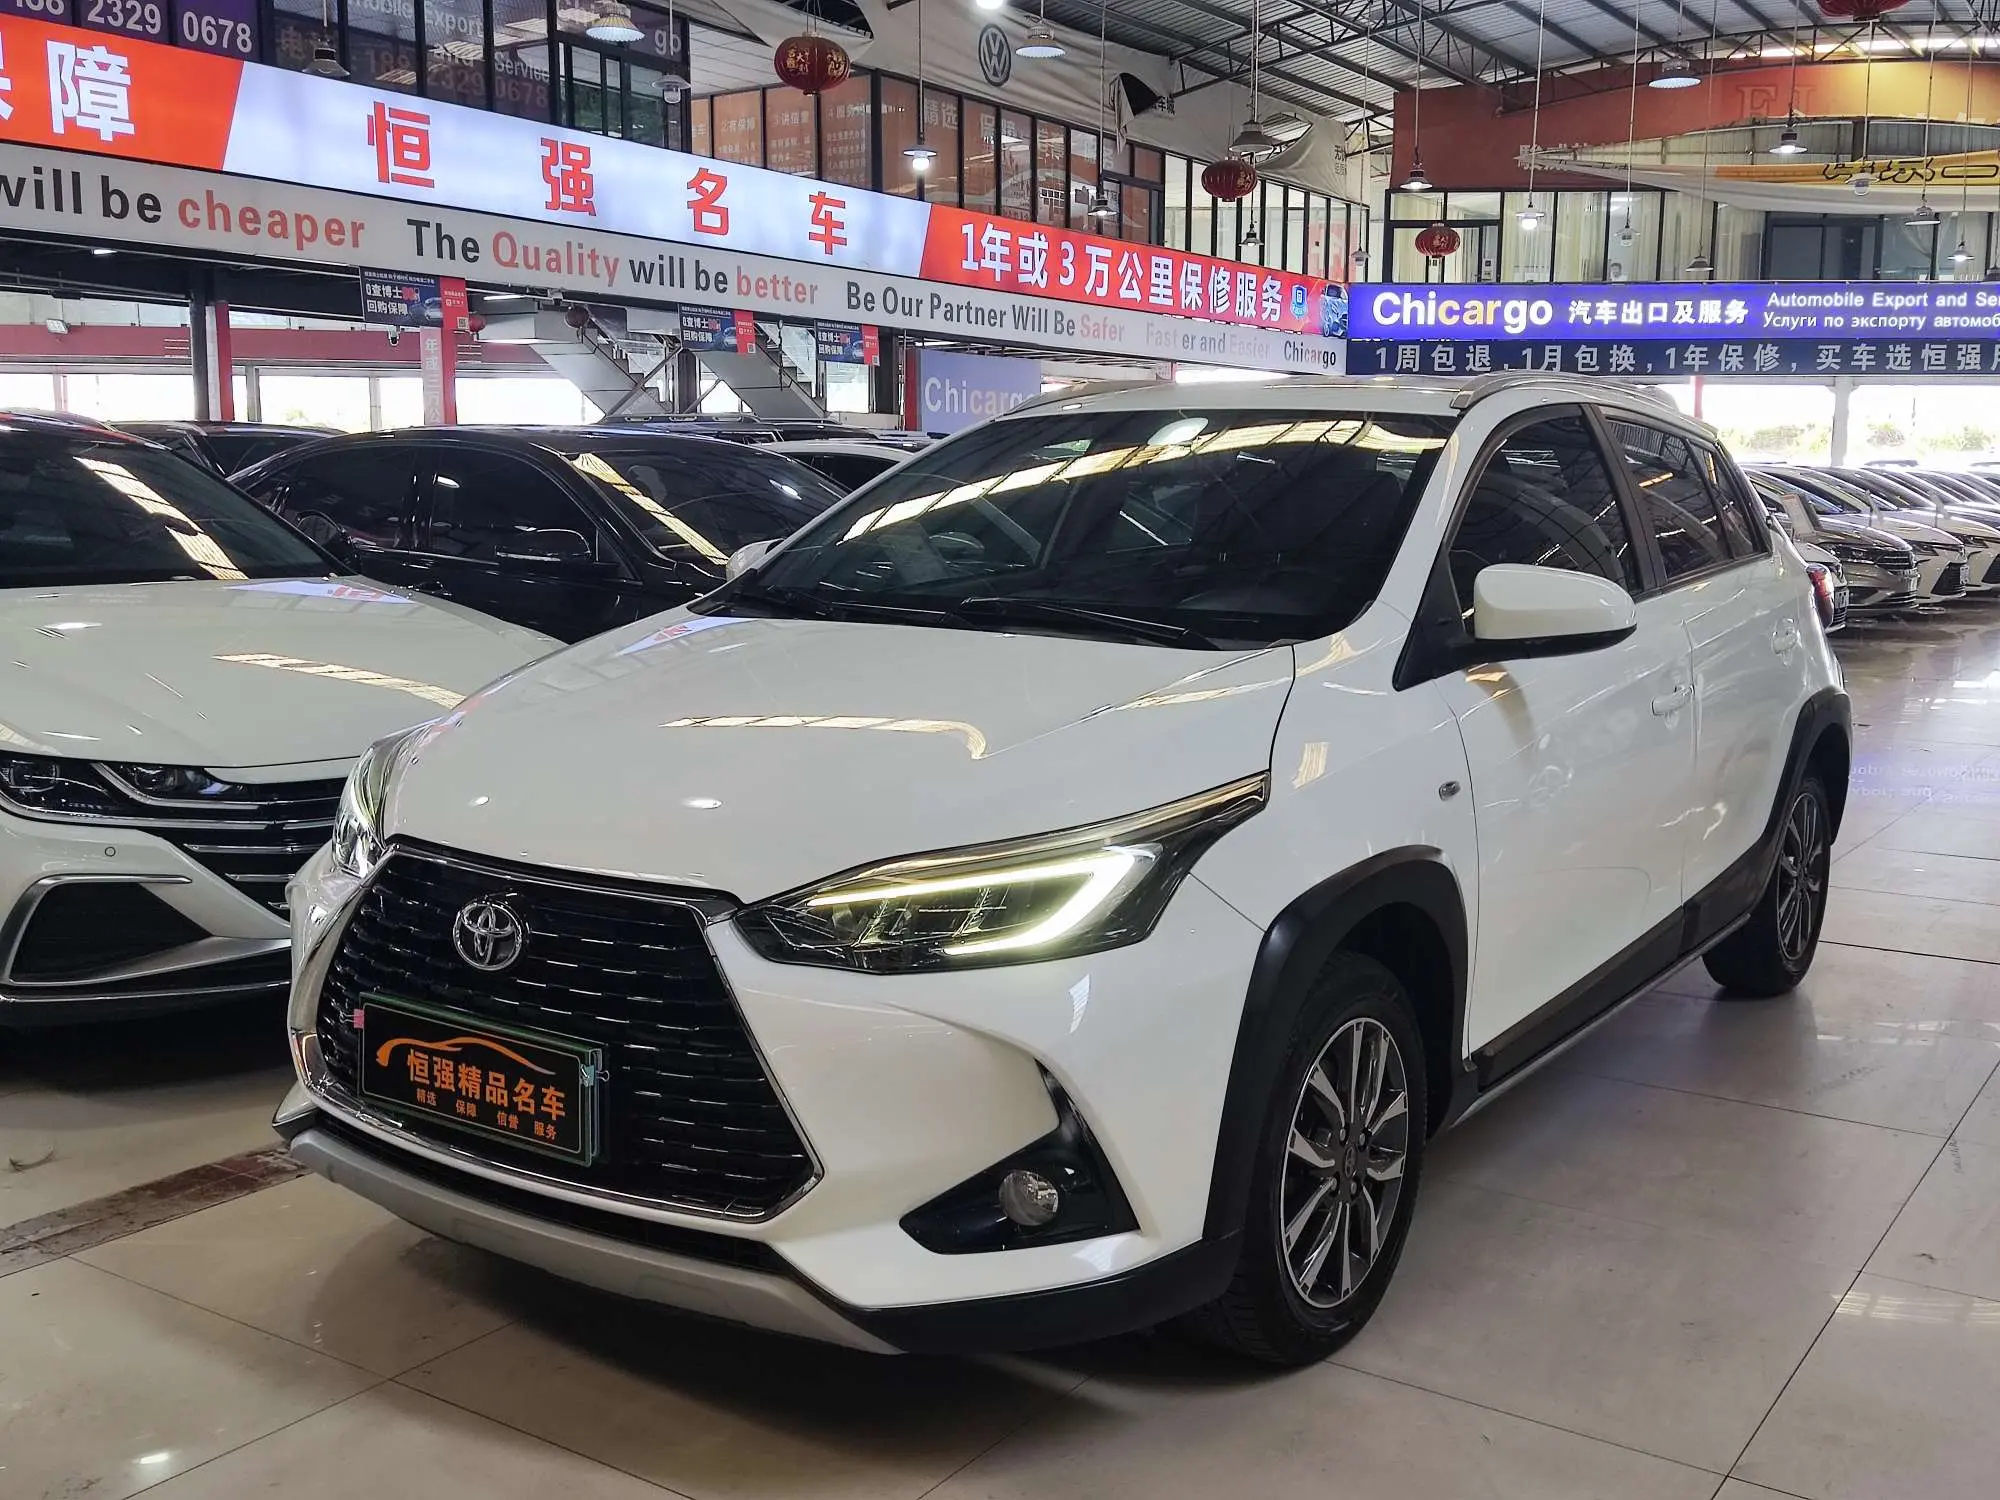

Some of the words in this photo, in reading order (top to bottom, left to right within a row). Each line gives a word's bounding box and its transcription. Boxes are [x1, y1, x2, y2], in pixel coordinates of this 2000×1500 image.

[87, 0, 162, 35] 2329
[183, 11, 252, 52] 0678
[367, 101, 848, 256] 恒强名车
[0, 166, 82, 214] will
[101, 174, 162, 223] be
[178, 189, 365, 252] cheaper
[406, 218, 480, 264] The
[492, 231, 620, 288] Quality
[629, 253, 686, 291] will
[694, 259, 729, 294] be
[735, 272, 819, 305] better
[846, 281, 876, 312] Be
[882, 285, 924, 318] Our
[929, 292, 1007, 329] Partner
[1012, 305, 1049, 334] Will
[1053, 310, 1077, 337] Be
[1080, 313, 1125, 343] Safer
[1200, 333, 1226, 354] and
[1284, 339, 1337, 368] Chicargo
[1372, 290, 1554, 334] Chicargo
[1568, 299, 1749, 325] 汽车出口及服务
[1763, 311, 1817, 331] Услуги
[1824, 315, 1844, 328] по
[1851, 315, 1926, 331] экспорту
[1767, 292, 1864, 308] Automobile
[1872, 292, 1928, 310] Export
[1936, 292, 1967, 308] and
[924, 376, 1037, 415] Chicar
[407, 1048, 567, 1121] 恒强精品名车
[416, 1087, 437, 1107] 精选
[455, 1099, 477, 1118] 保障
[533, 1120, 558, 1141] 服务
